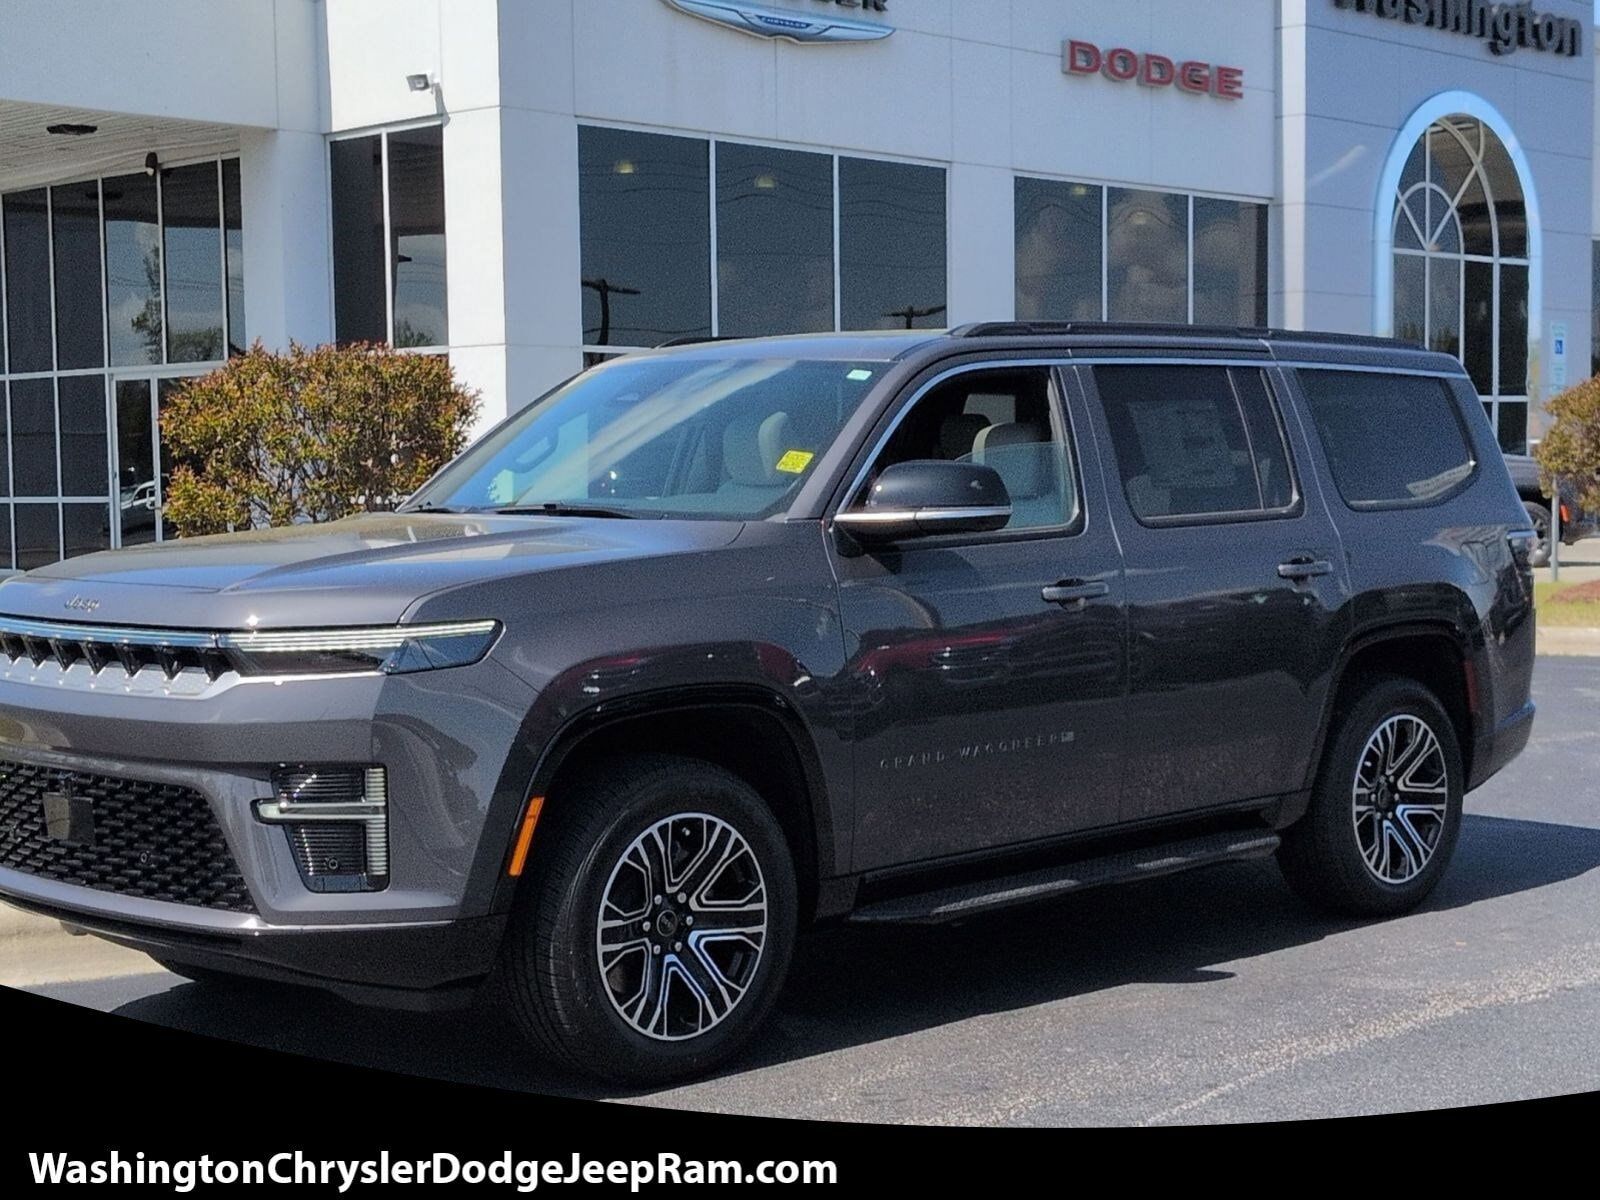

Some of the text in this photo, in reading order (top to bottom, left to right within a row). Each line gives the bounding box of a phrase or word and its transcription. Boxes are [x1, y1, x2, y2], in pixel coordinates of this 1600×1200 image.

[1331, 0, 1583, 57] ashington
[1062, 39, 1244, 100] DODGE
[880, 750, 945, 769] GRAND
